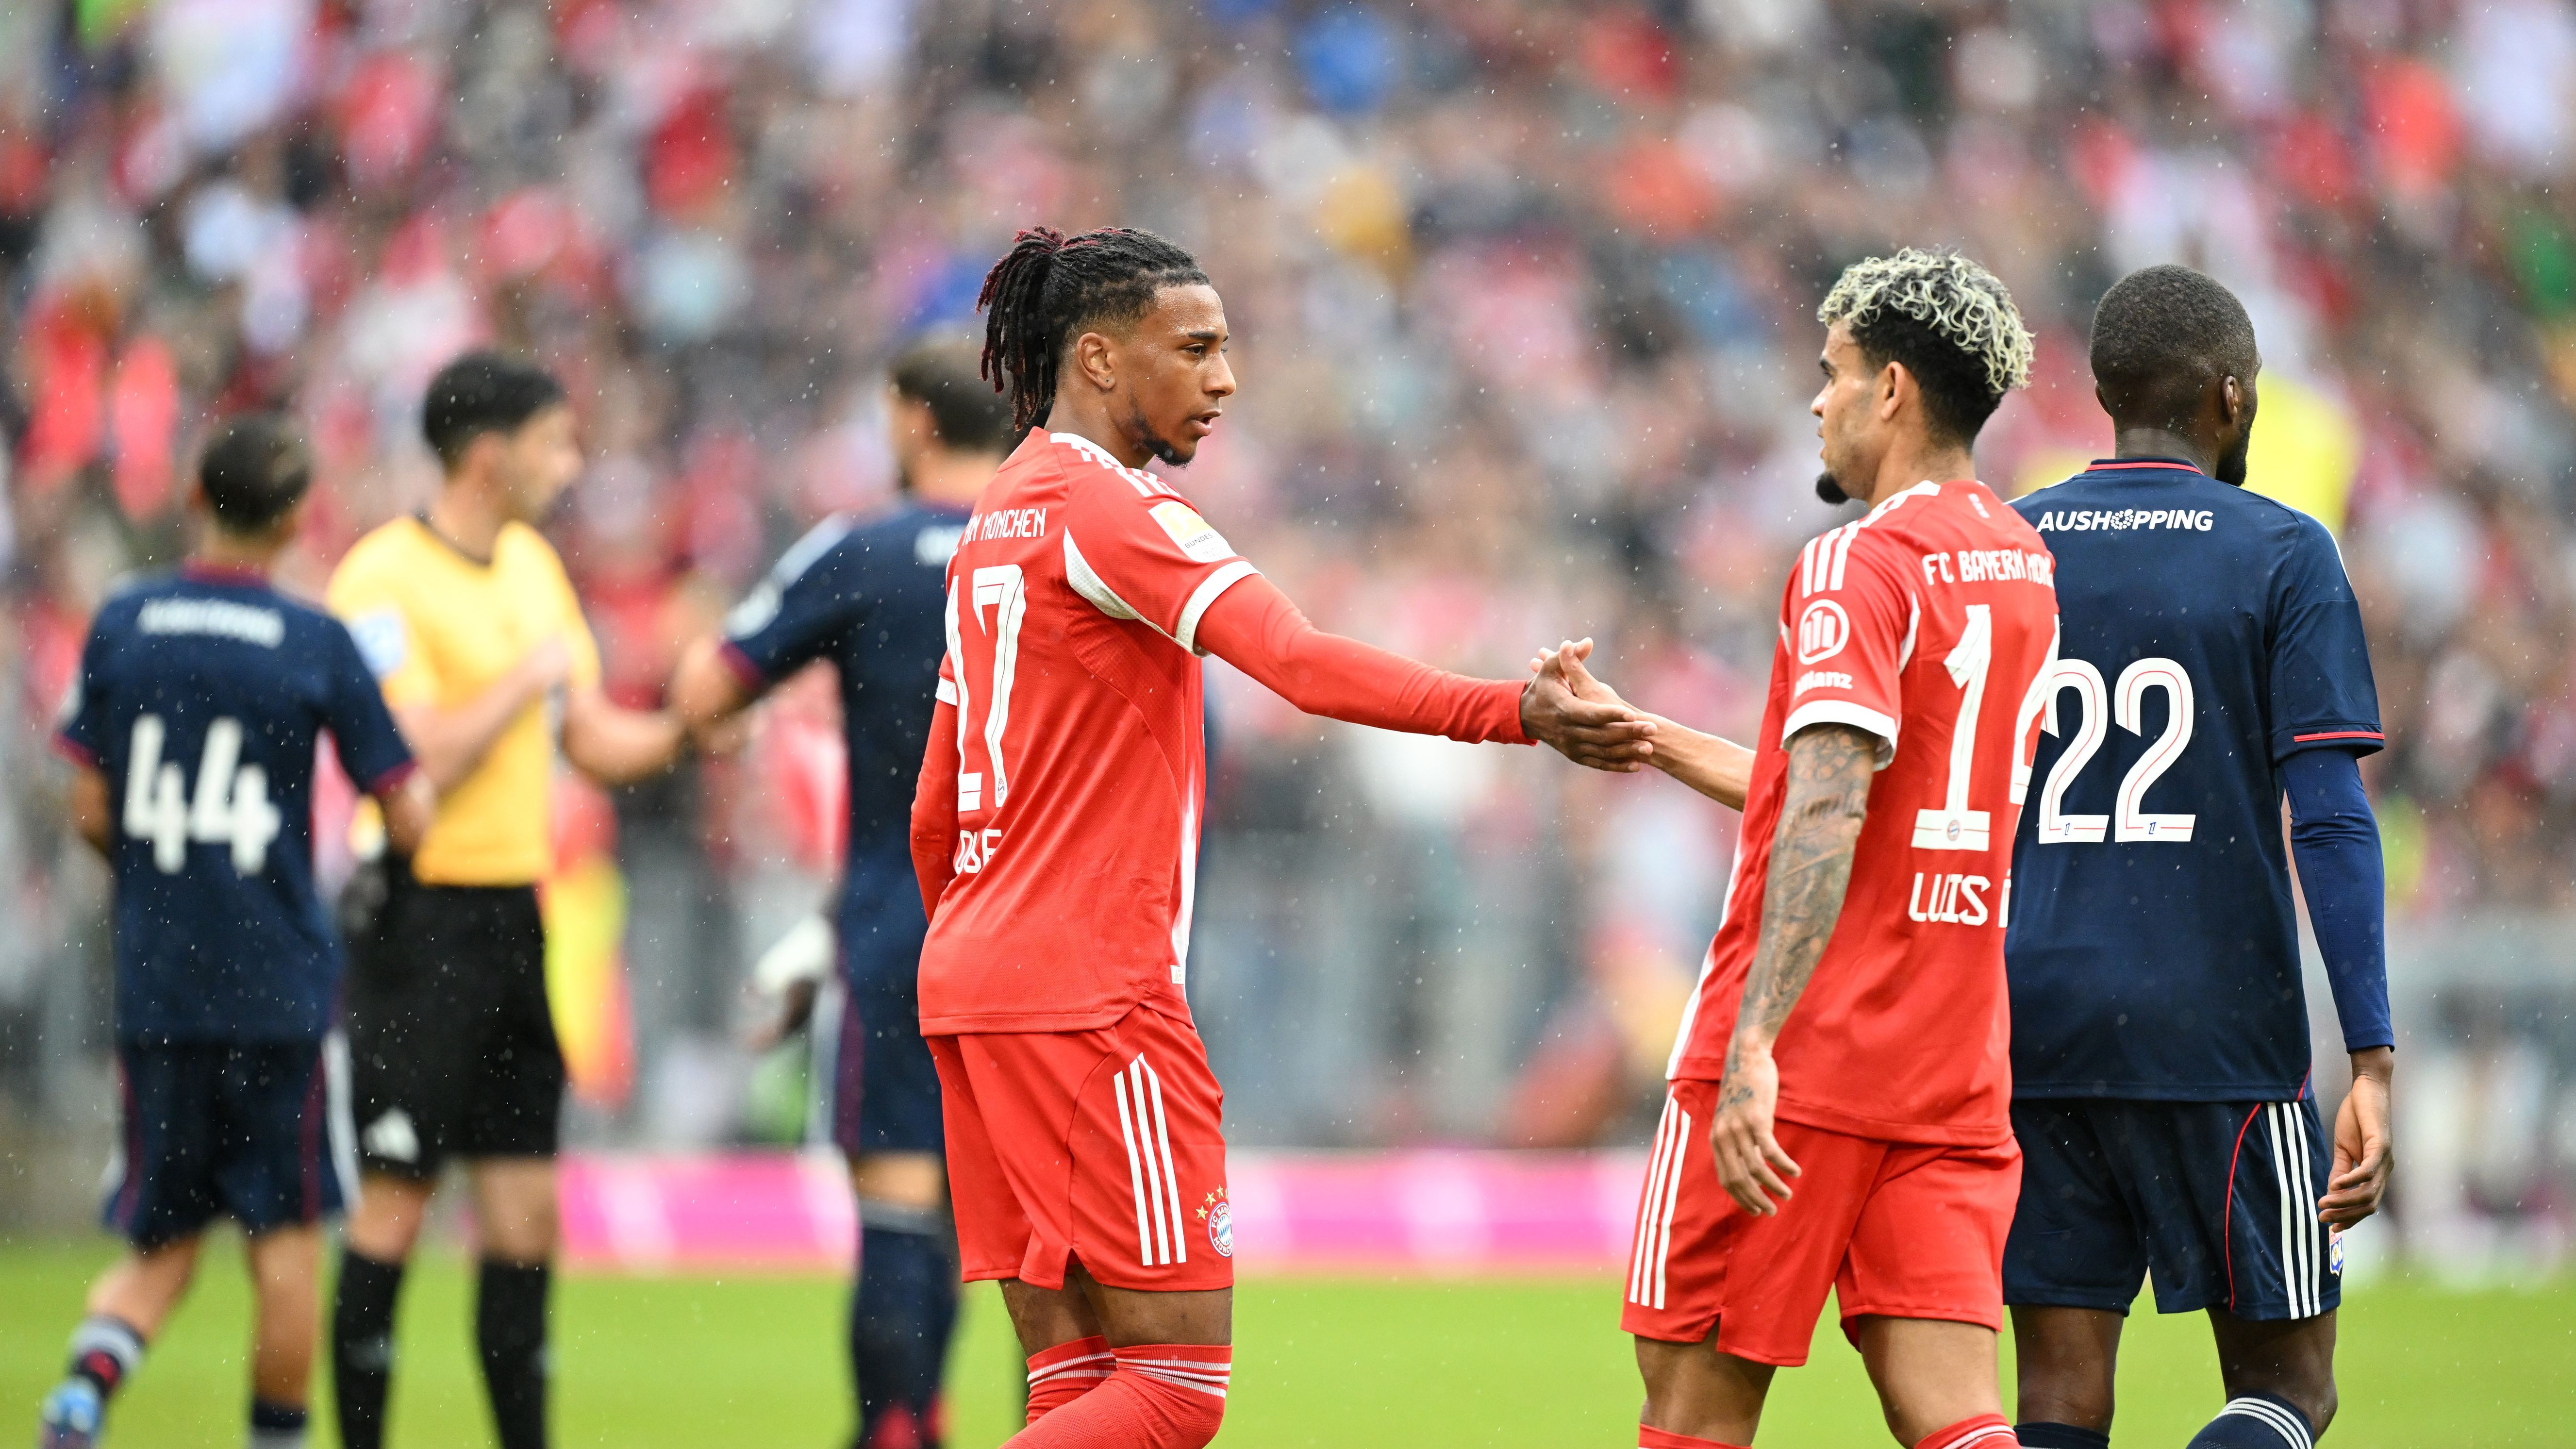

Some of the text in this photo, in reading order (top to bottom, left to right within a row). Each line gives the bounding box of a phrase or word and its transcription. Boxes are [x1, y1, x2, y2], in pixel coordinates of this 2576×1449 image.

[1922, 552, 1954, 585] FC
[1958, 549, 2027, 583] BAYERN
[2036, 509, 2213, 532] AUSHOPPING
[945, 564, 1026, 811] 17
[123, 714, 282, 874] 44
[2039, 658, 2196, 844] 22
[1908, 872, 1991, 926] LUIS
